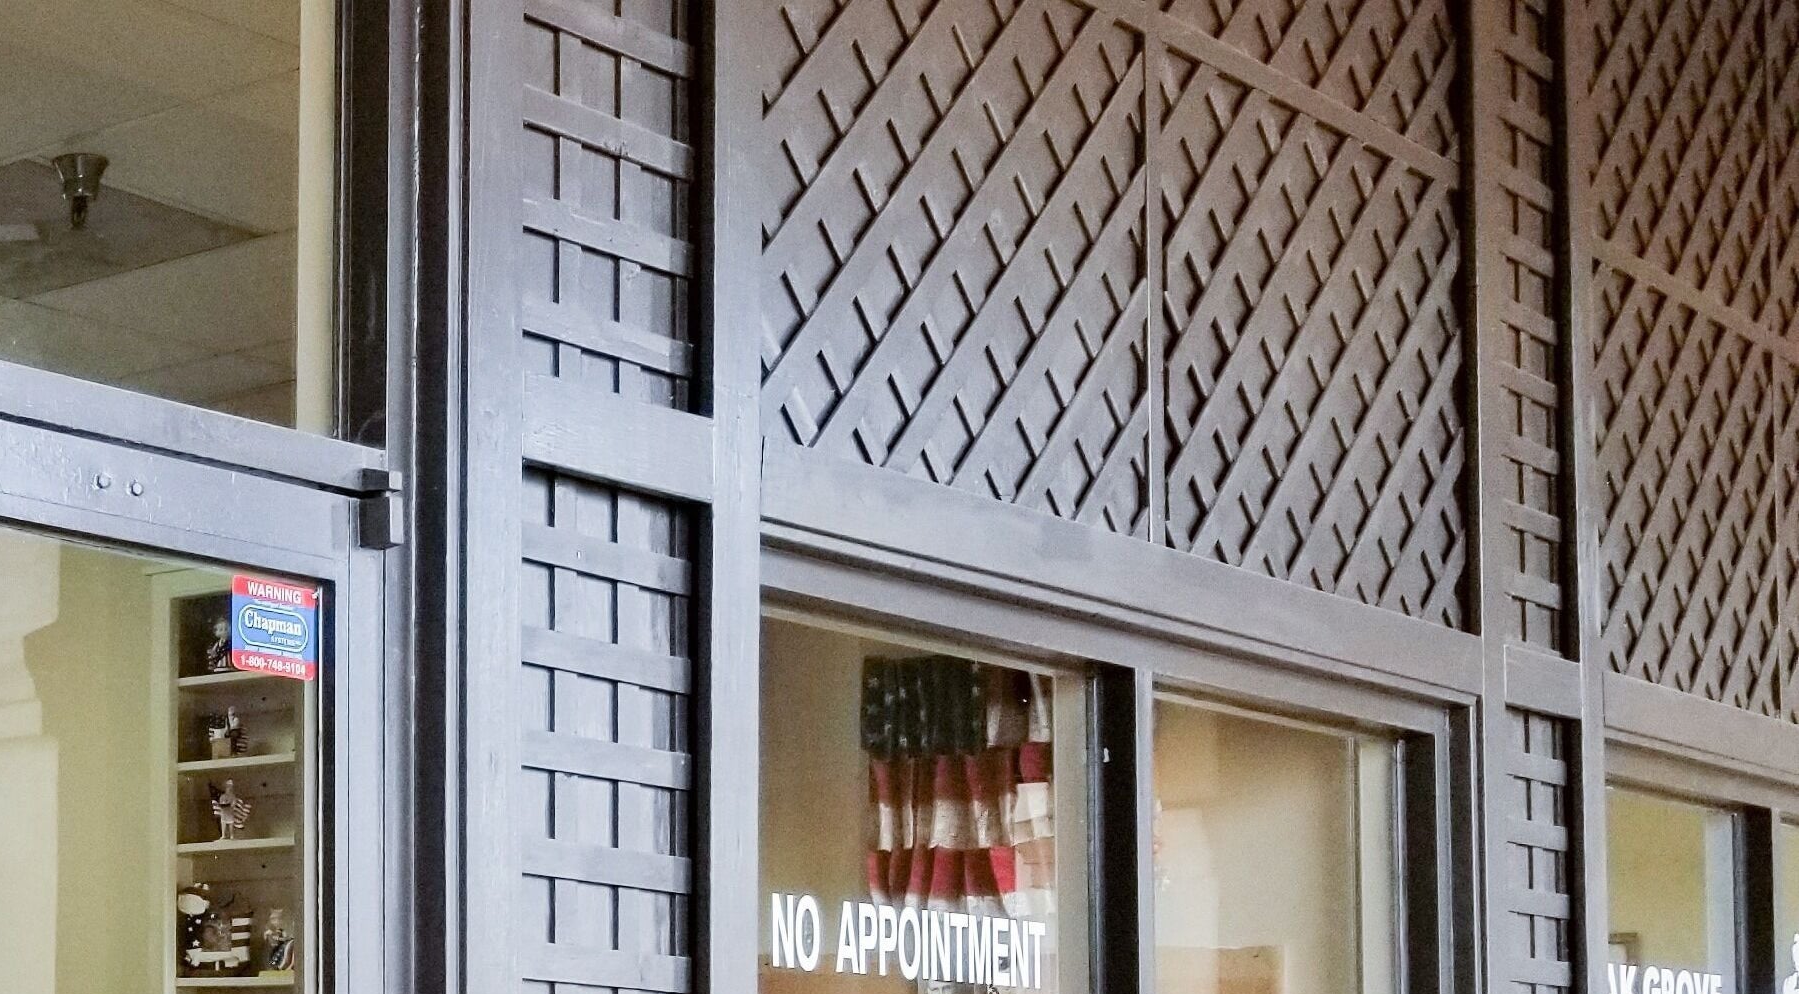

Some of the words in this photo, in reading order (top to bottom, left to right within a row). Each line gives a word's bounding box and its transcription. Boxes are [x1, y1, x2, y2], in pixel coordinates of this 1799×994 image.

[247, 580, 302, 604] WARNING
[244, 609, 302, 636] Chapman
[772, 892, 820, 971] NO
[836, 901, 1045, 989] APPOINTMENT
